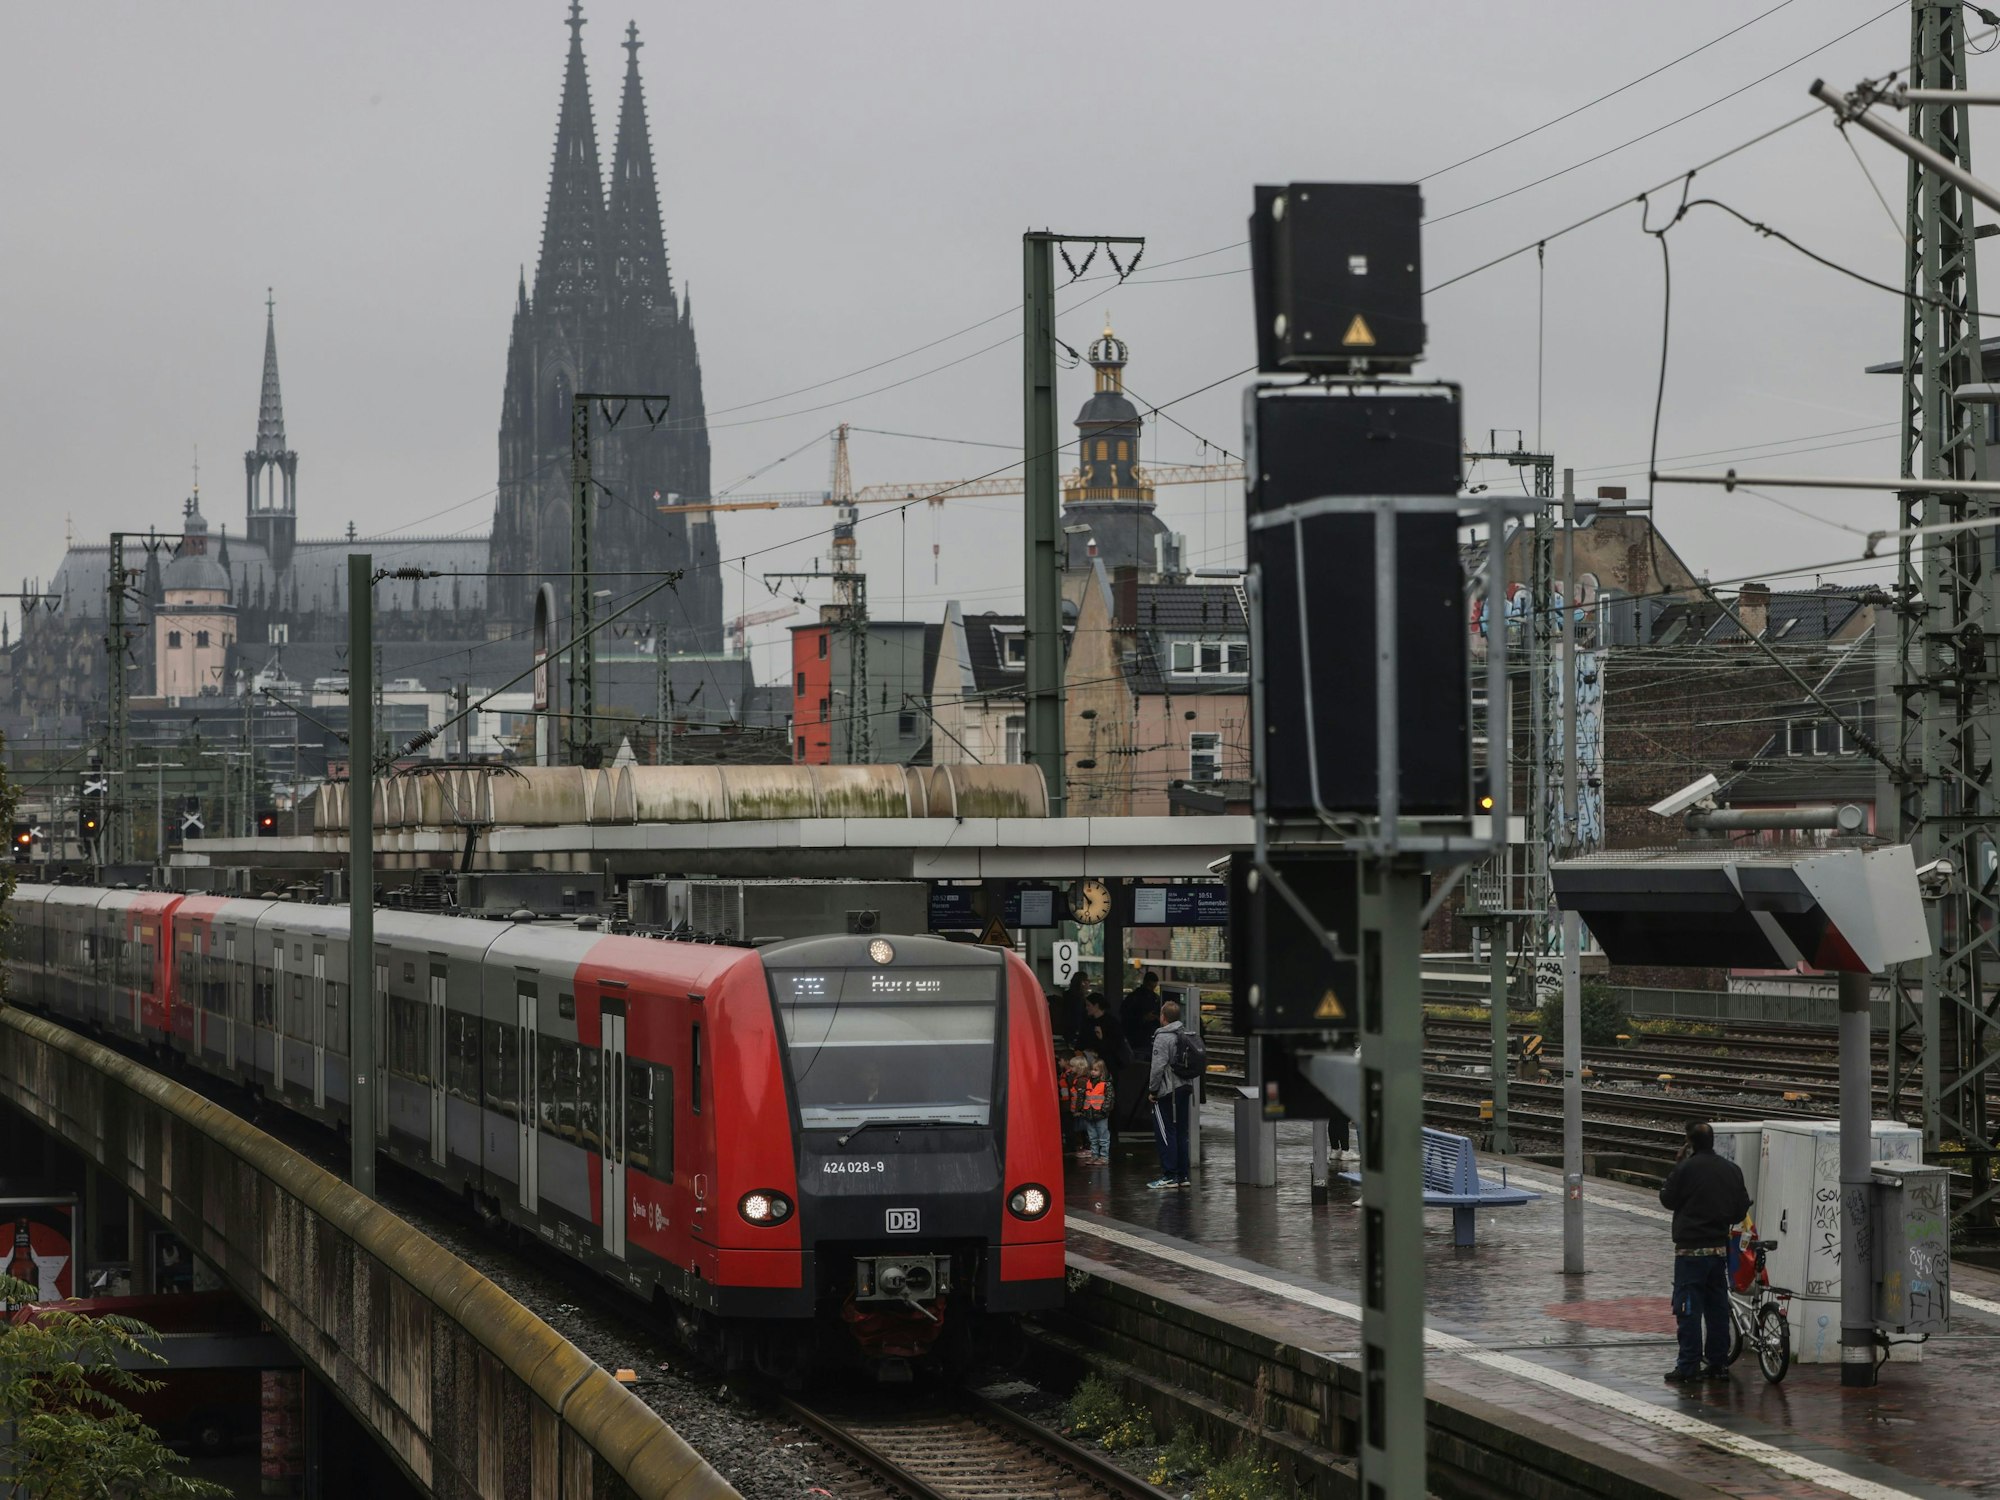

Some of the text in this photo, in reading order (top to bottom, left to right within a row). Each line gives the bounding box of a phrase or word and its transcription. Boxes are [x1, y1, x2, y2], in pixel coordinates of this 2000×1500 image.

[823, 1161, 884, 1174] 424 028-9
[888, 1211, 918, 1231] DB
